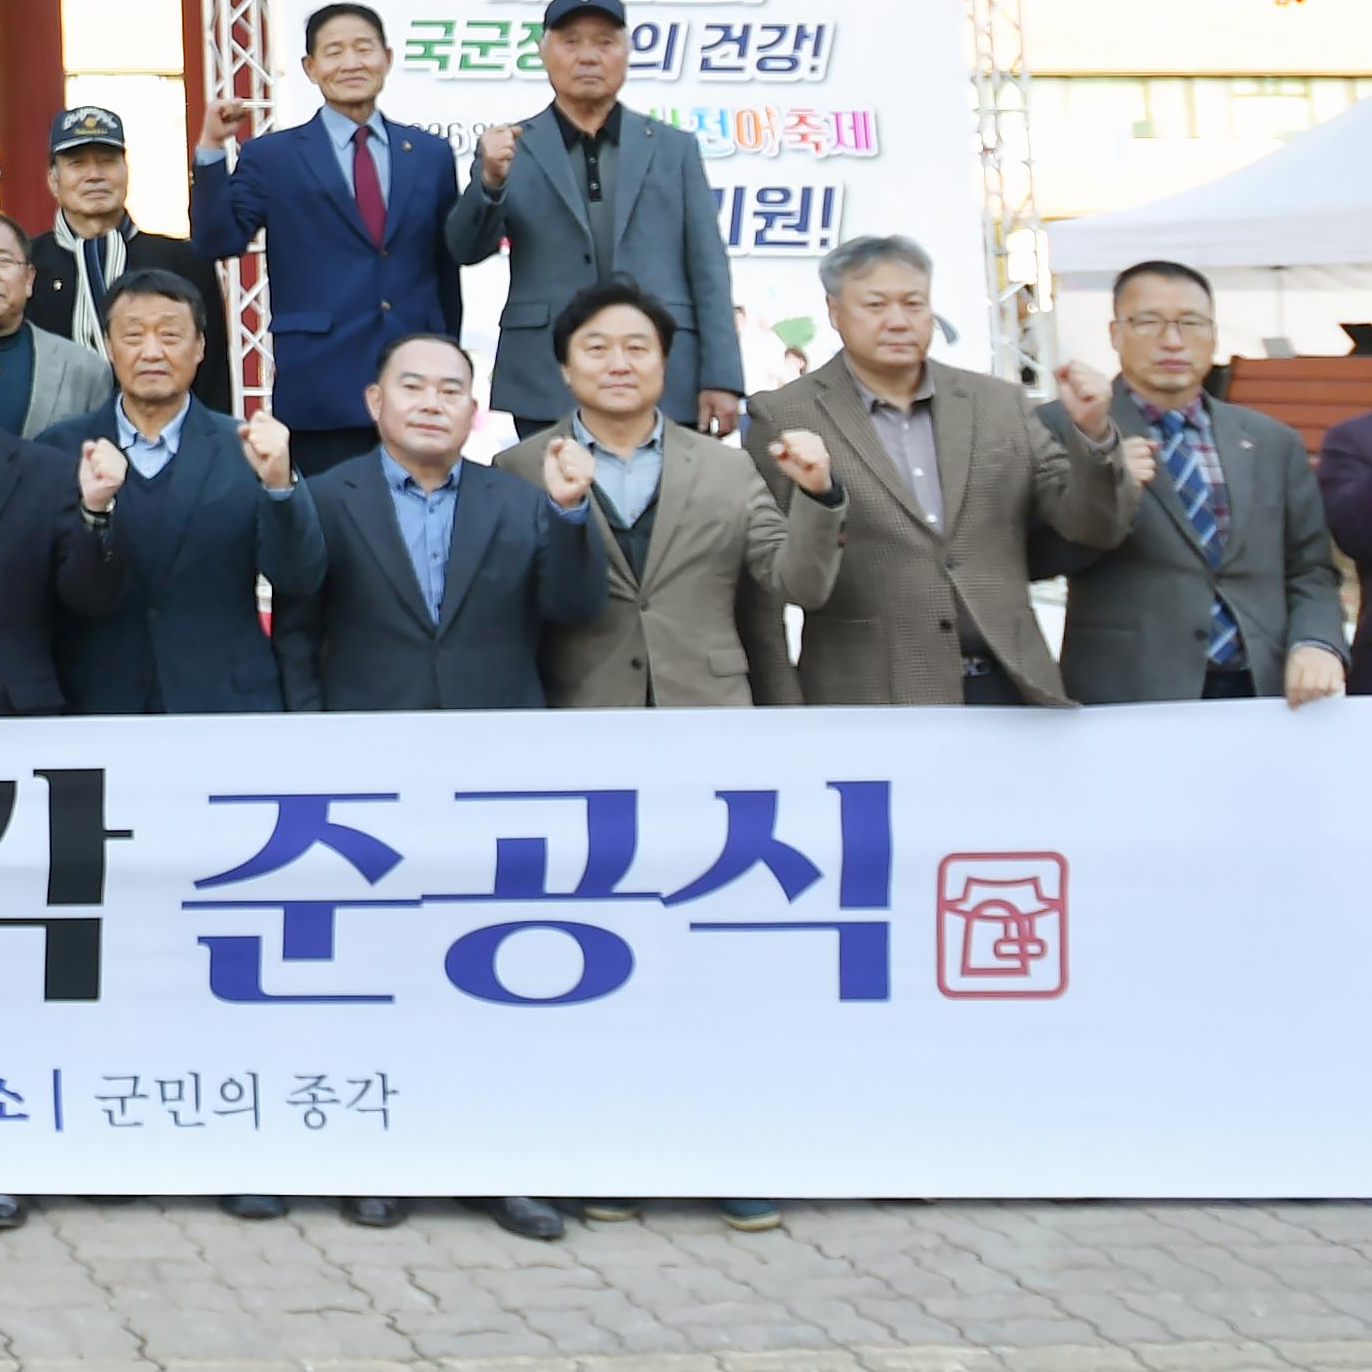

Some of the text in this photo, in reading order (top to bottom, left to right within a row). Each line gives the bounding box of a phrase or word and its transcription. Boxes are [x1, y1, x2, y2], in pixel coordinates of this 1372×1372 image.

[699, 22, 826, 74] 건강!
[180, 779, 894, 1008] 준공식
[94, 1071, 260, 1131] 군민의
[286, 1071, 400, 1130] 종각
